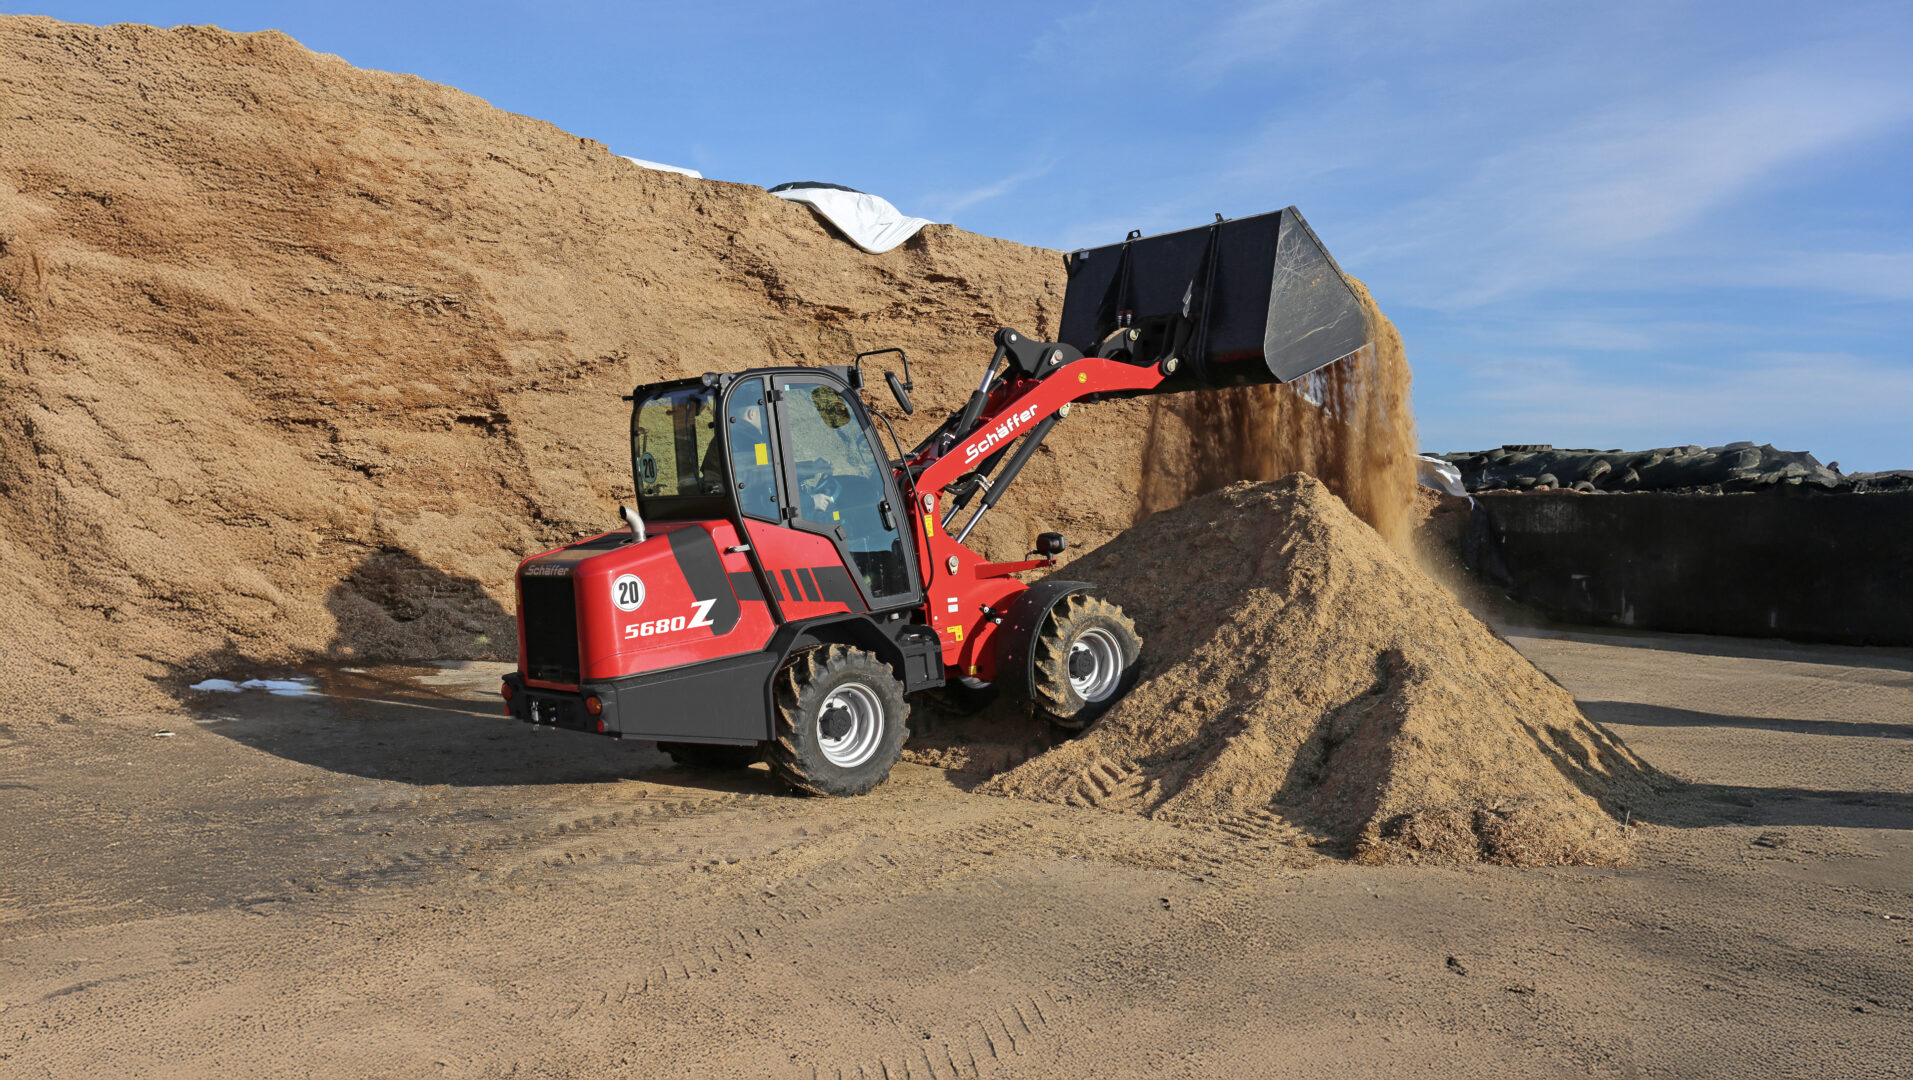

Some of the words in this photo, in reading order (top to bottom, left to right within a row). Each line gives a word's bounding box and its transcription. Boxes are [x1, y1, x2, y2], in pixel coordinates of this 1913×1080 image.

[964, 404, 1038, 464] Schäffer
[642, 458, 655, 478] 20
[525, 564, 570, 577] Schäffer
[618, 581, 640, 605] 20
